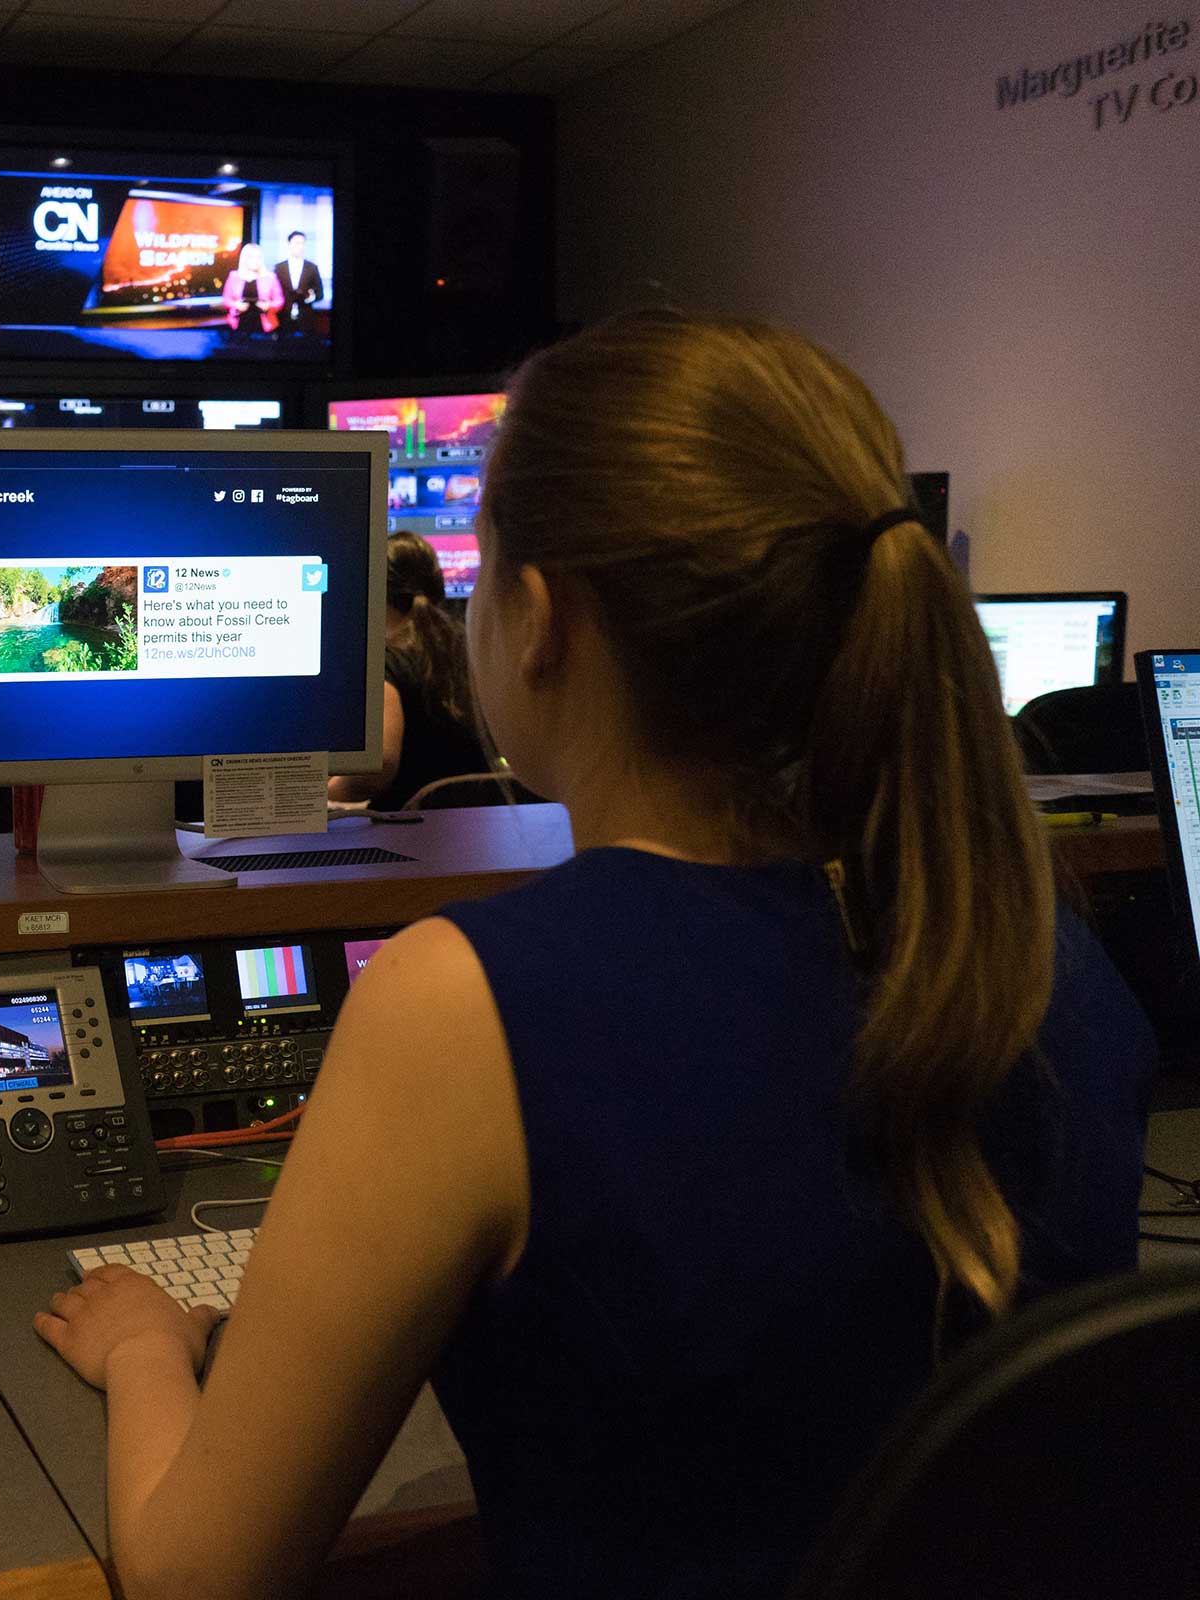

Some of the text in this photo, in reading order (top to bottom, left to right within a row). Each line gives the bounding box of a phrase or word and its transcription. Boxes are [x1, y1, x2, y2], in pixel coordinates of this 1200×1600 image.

[996, 20, 1190, 110] Marguerite
[1088, 84, 1140, 130] TV
[33, 201, 99, 242] CN
[276, 494, 319, 504] #tagboard
[175, 568, 188, 577] 12
[190, 568, 220, 577] News
[175, 582, 217, 592] @12News
[143, 599, 288, 612] Here's what you need to
[143, 613, 290, 627] know about Fossil Creek
[143, 632, 243, 646] permits this year
